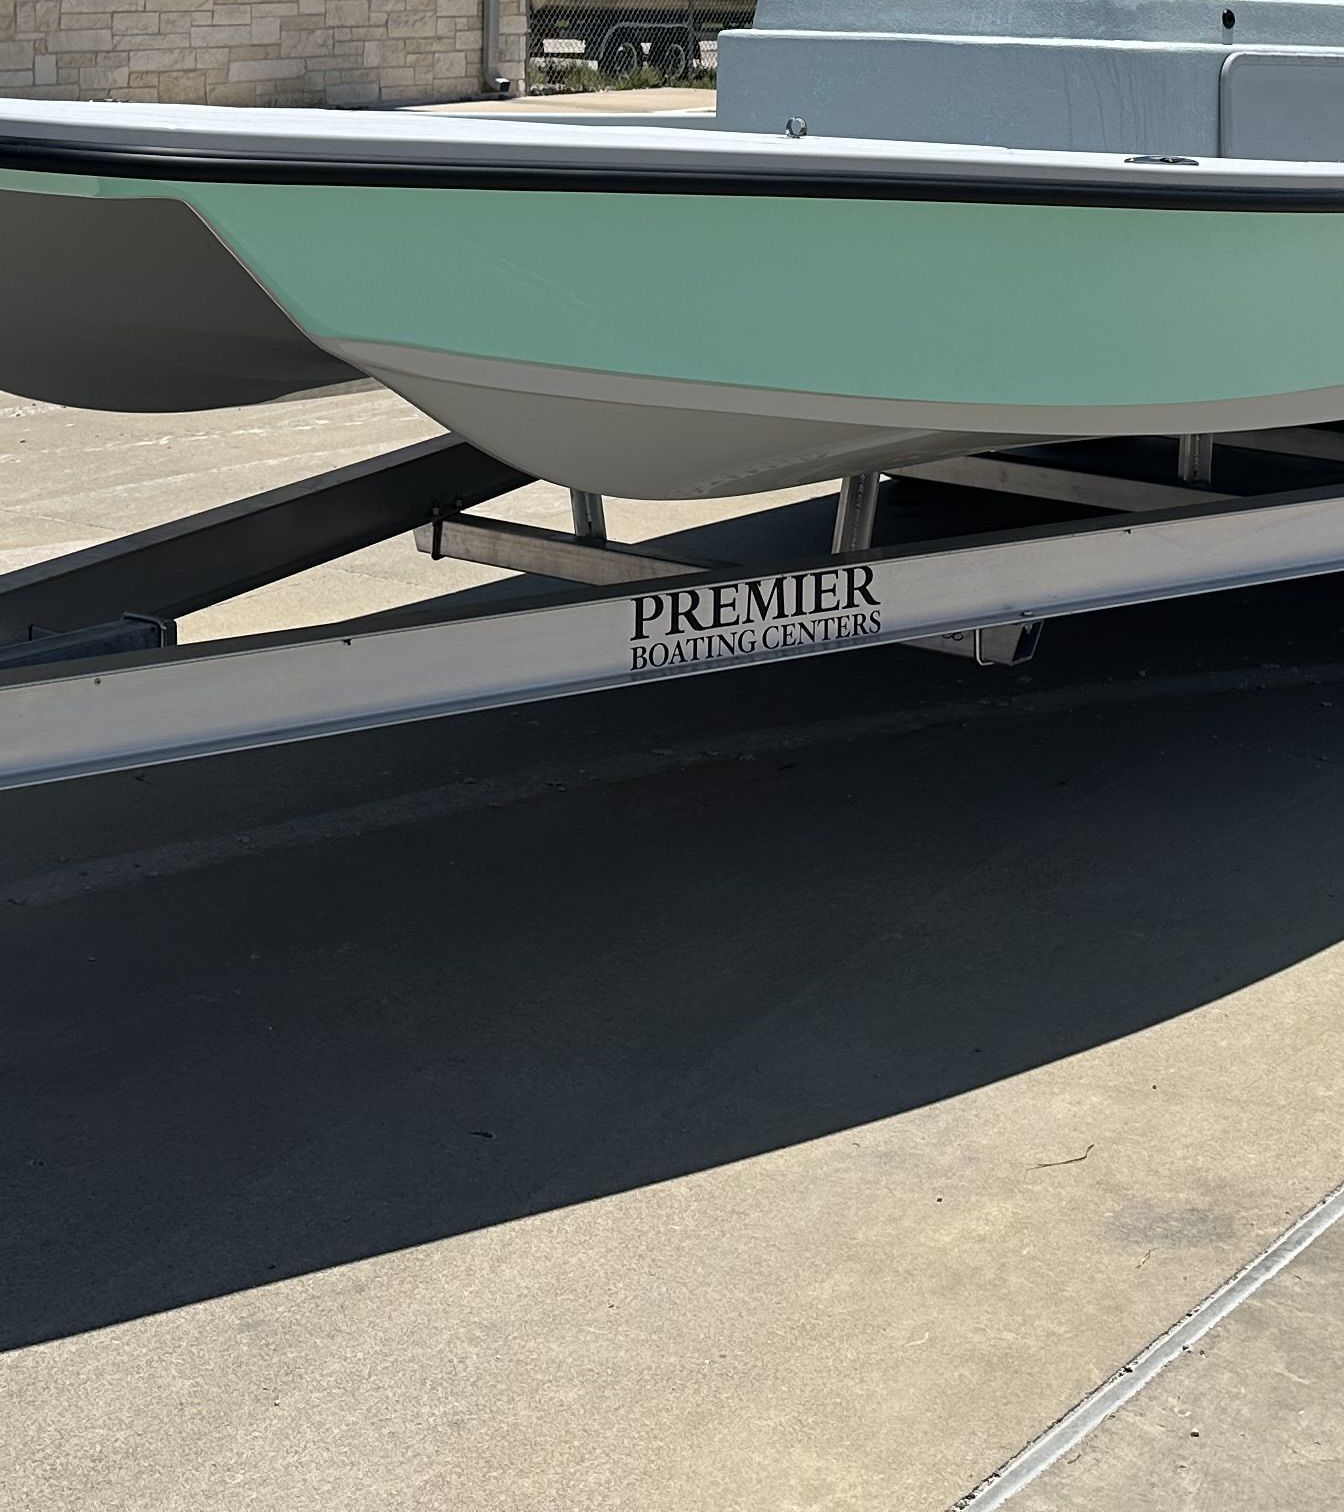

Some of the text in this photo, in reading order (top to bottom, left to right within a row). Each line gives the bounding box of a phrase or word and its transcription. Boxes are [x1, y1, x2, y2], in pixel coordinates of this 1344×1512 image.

[630, 565, 881, 641] PREMIER
[630, 610, 882, 671] BOATING CENTERS
